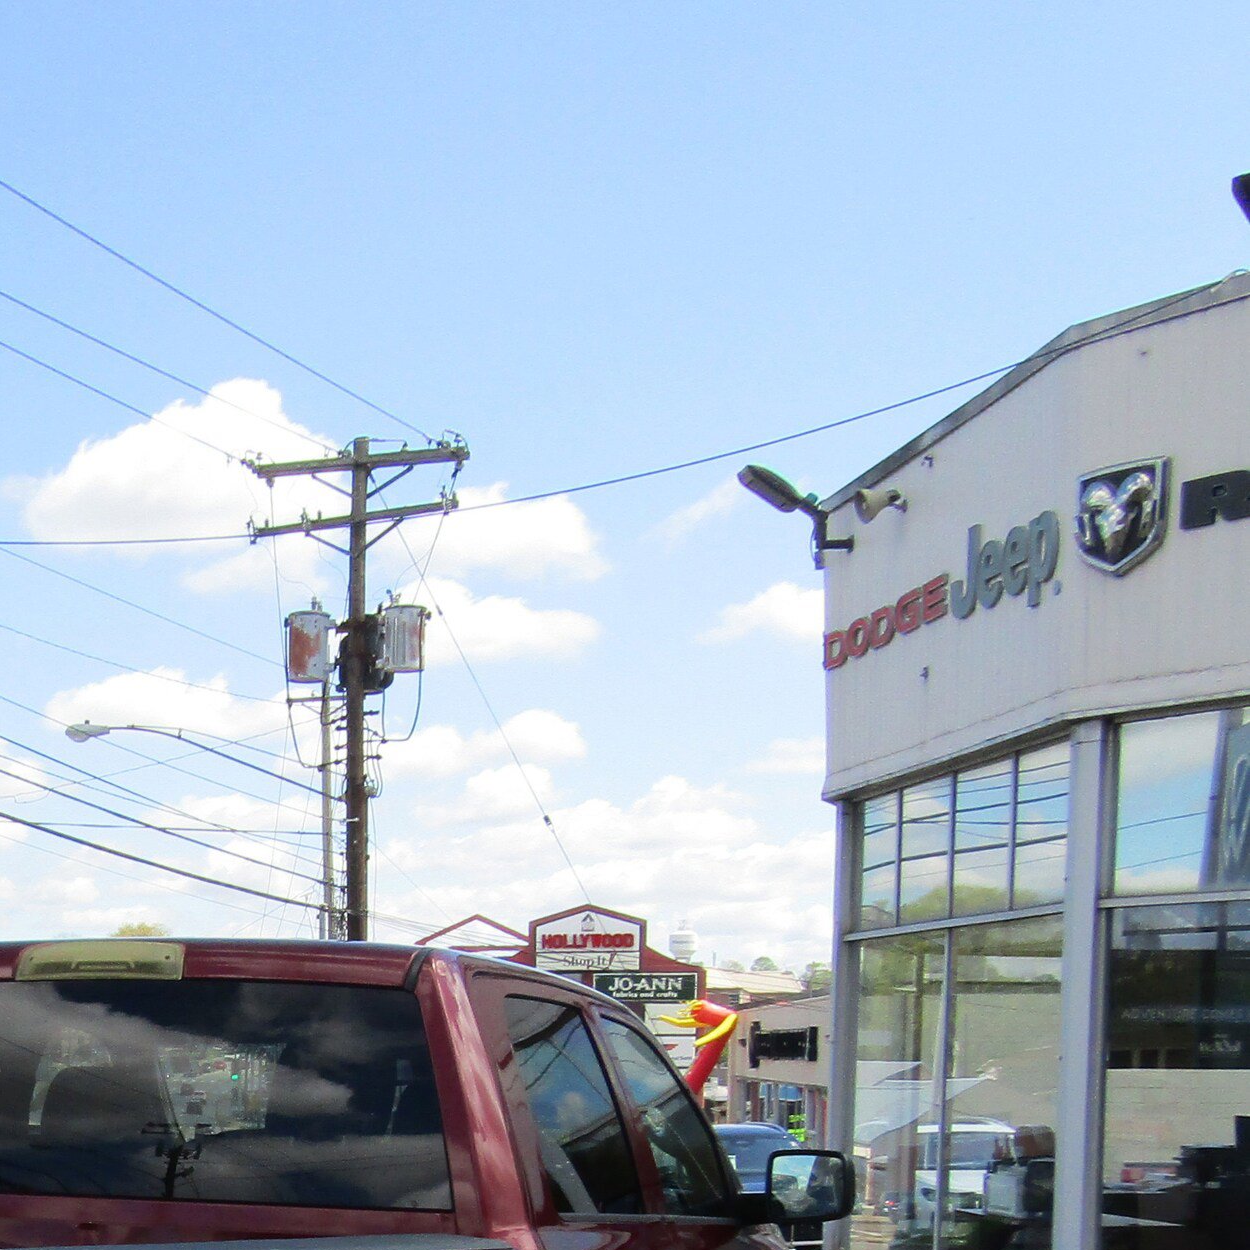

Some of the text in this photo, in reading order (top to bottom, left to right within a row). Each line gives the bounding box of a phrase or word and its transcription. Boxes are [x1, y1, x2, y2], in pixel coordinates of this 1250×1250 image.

[823, 510, 1060, 670] DODGE Jeep
[541, 933, 634, 949] HOLLYWOOD
[563, 955, 594, 969] Shop
[608, 977, 683, 991] JO-ANN
